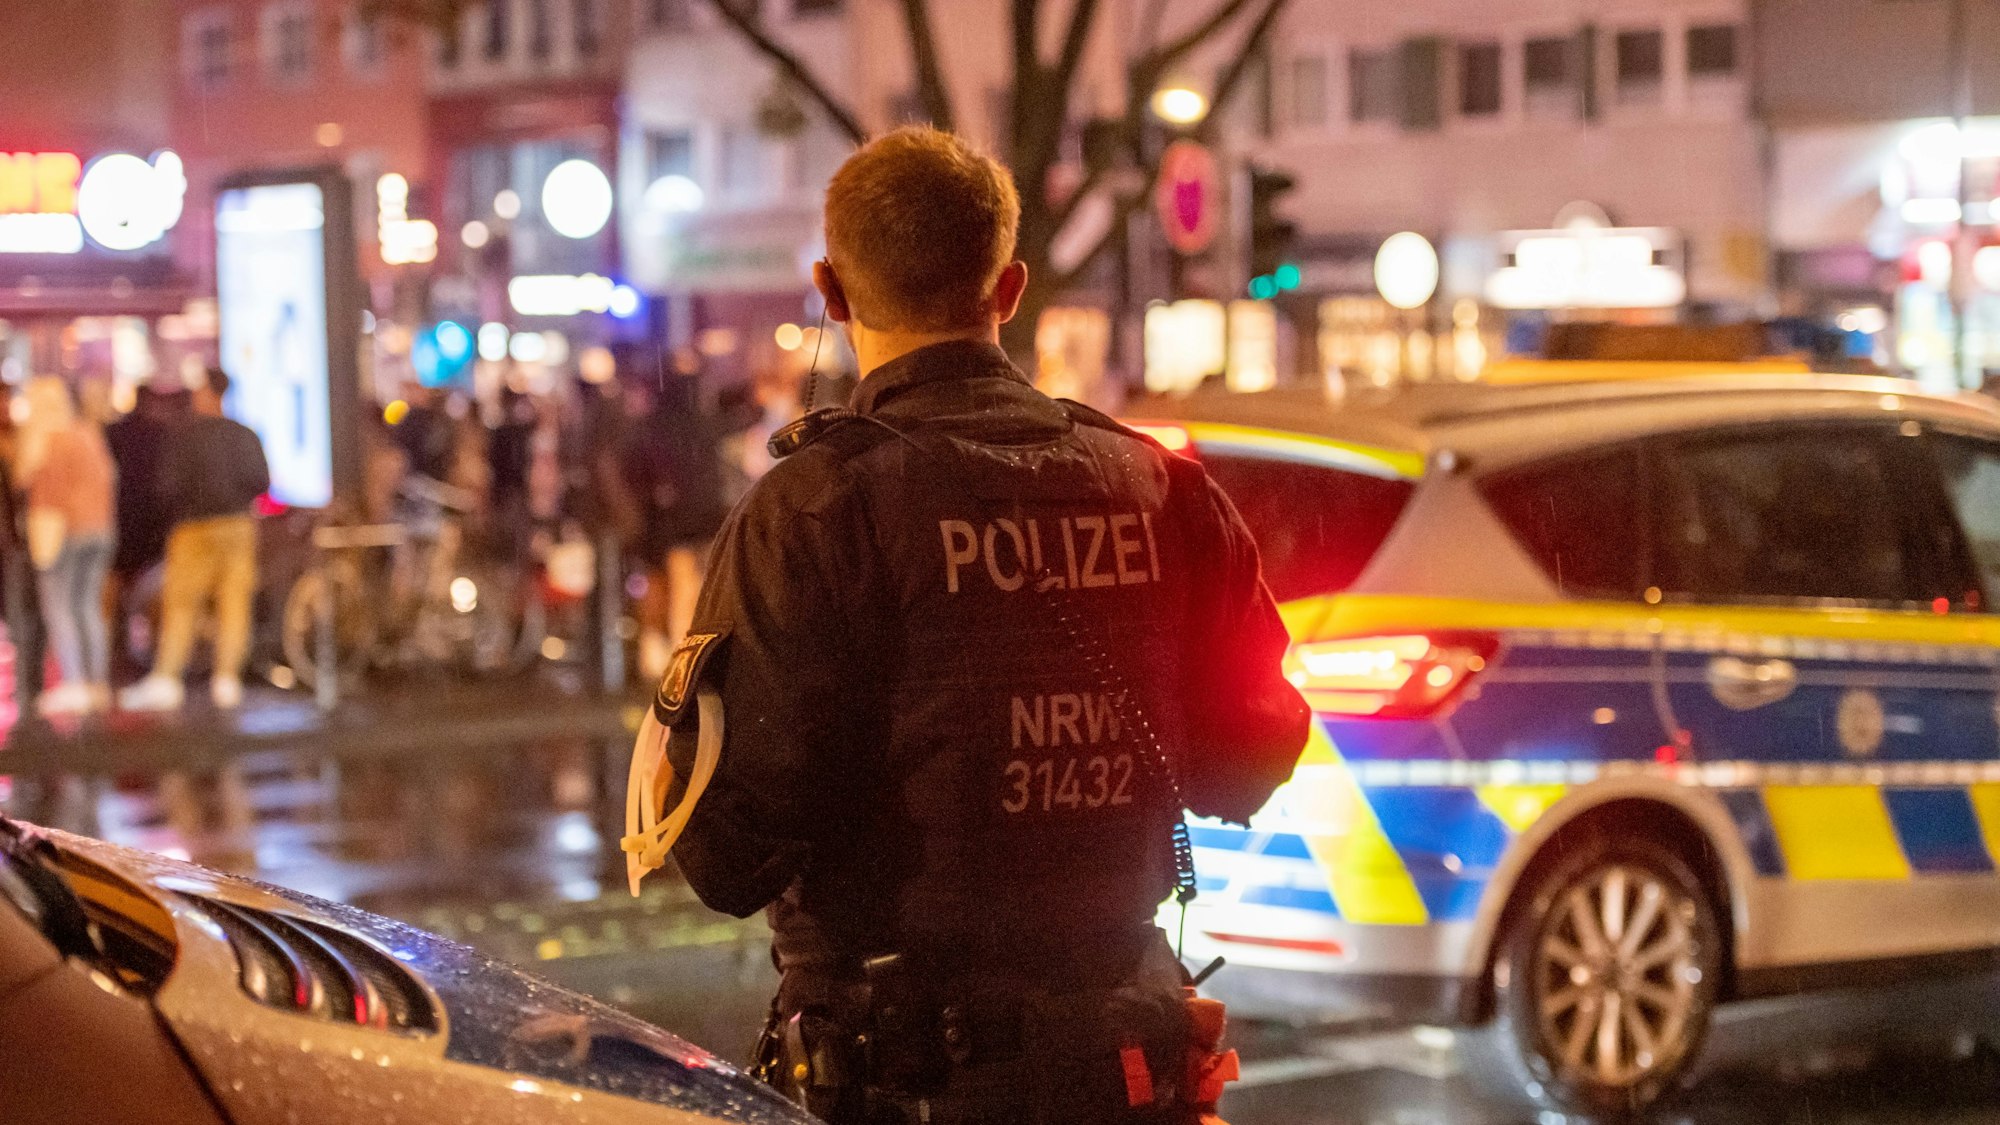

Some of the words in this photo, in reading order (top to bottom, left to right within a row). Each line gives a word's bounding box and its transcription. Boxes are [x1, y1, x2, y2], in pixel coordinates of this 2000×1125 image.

[939, 512, 1160, 593] POLIZEI
[1010, 692, 1127, 749] NRW
[1002, 755, 1133, 813] 31432
